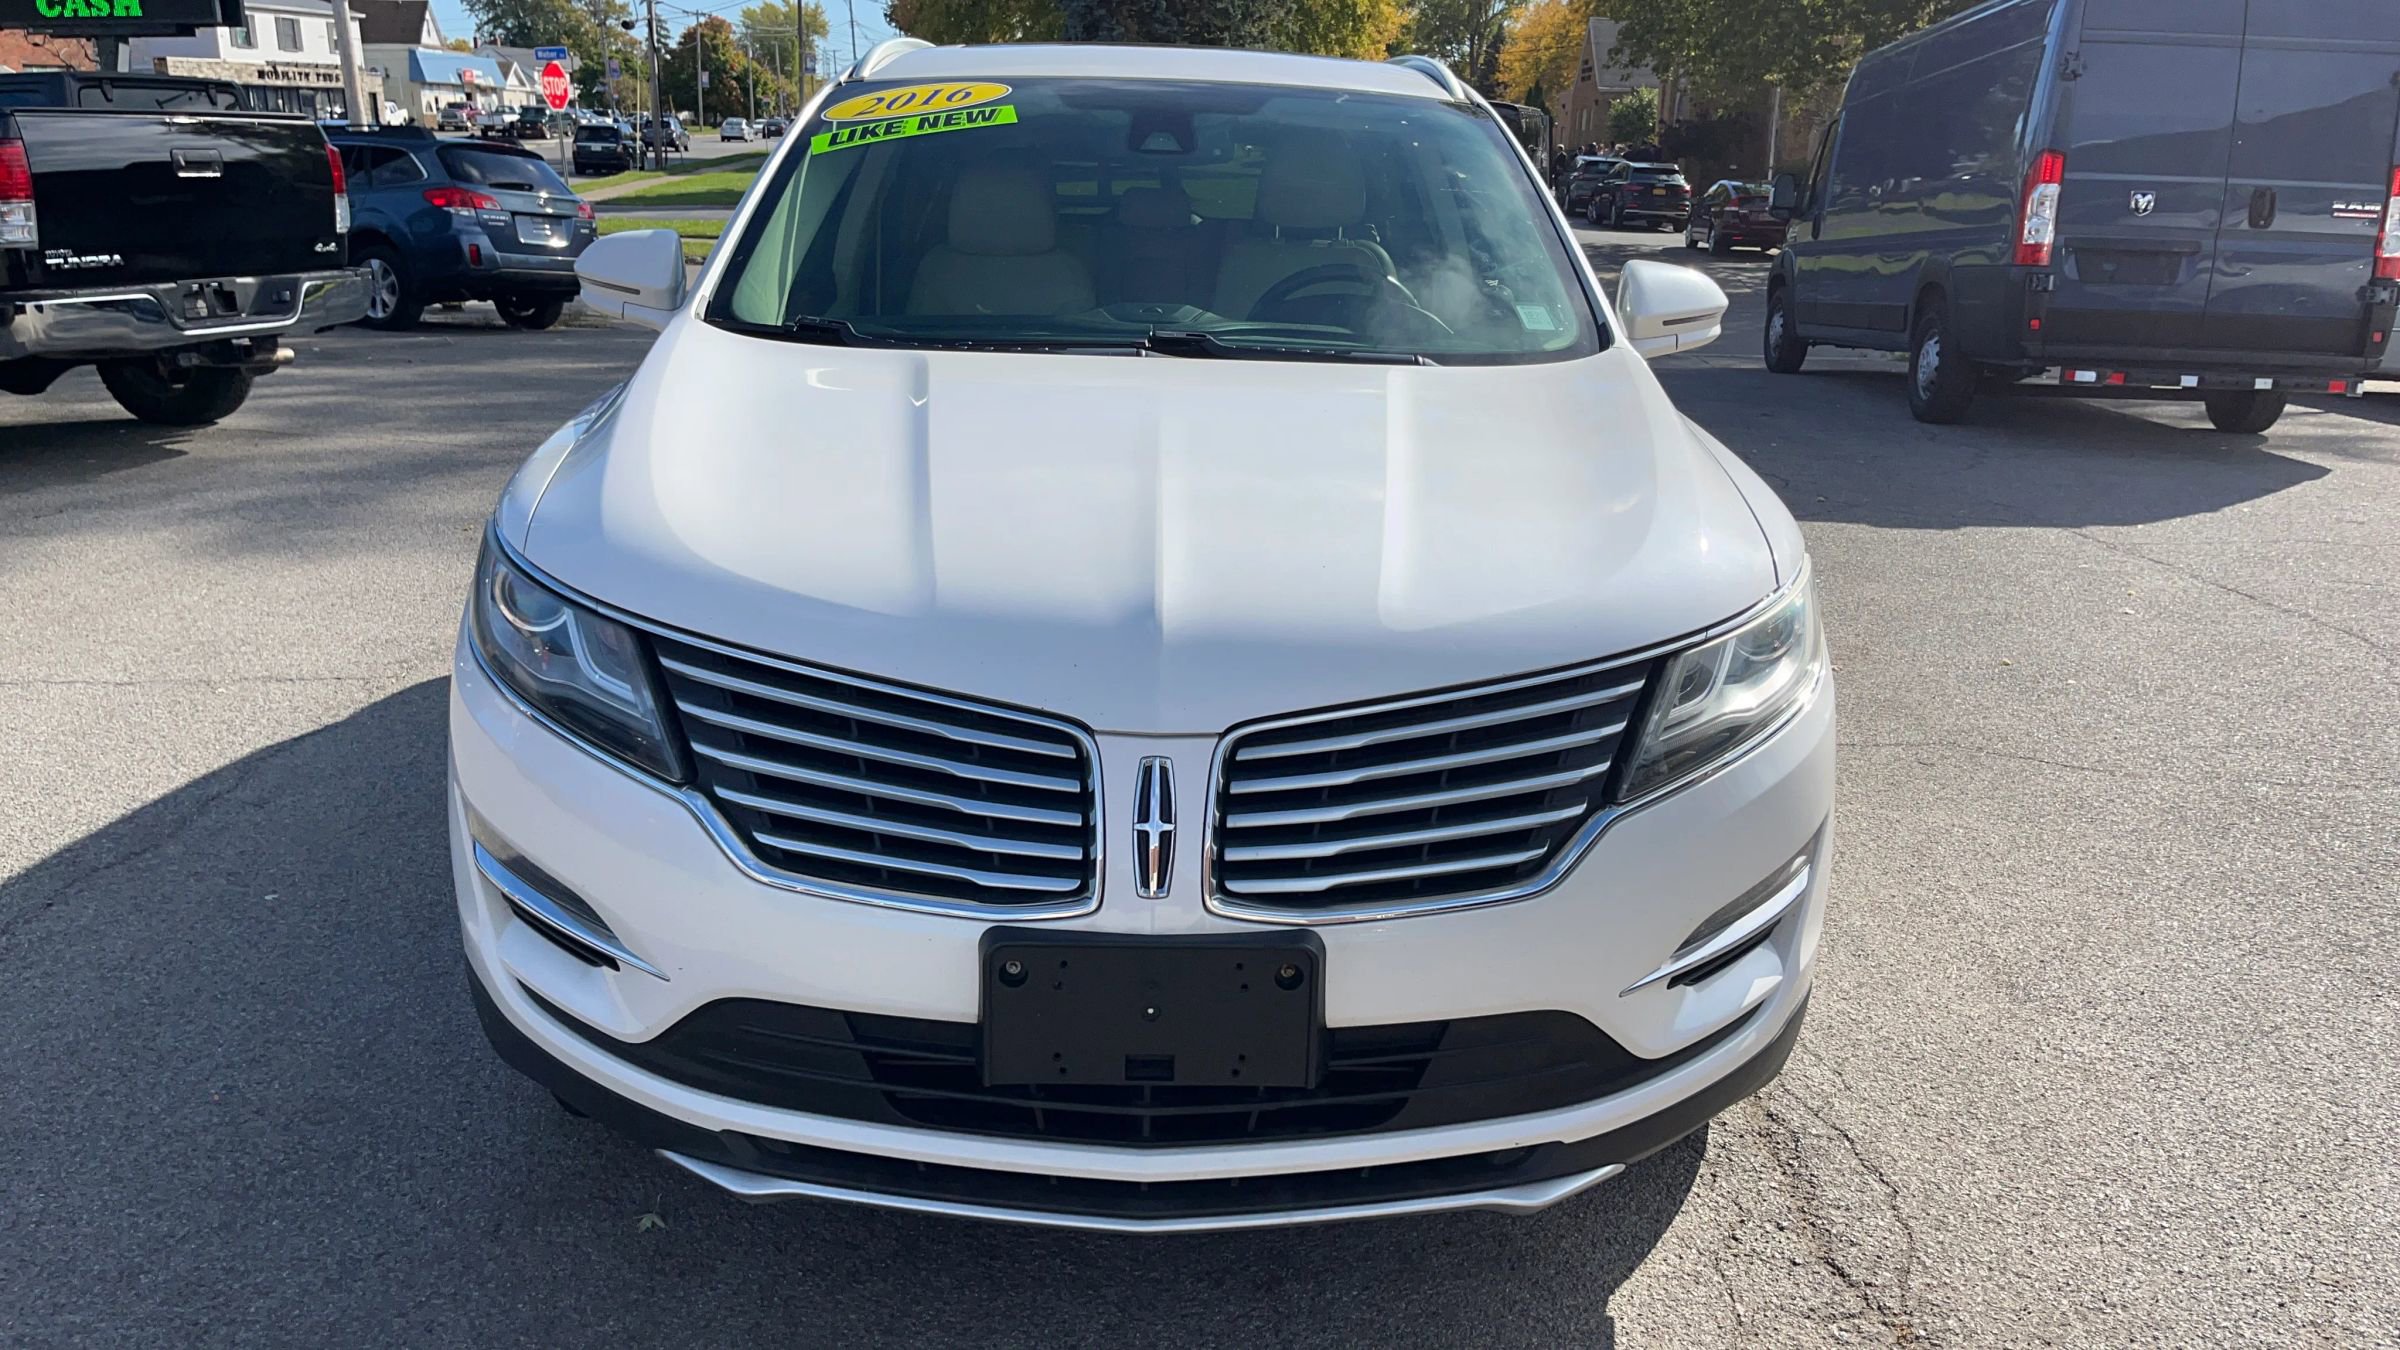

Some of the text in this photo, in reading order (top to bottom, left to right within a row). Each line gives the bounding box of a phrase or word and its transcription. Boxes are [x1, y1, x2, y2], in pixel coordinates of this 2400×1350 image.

[36, 0, 142, 17] CASH
[543, 77, 566, 96] STOP
[851, 86, 976, 118] 2016
[828, 108, 1001, 147] LIKE NEW
[46, 255, 124, 270] TUNDRA
